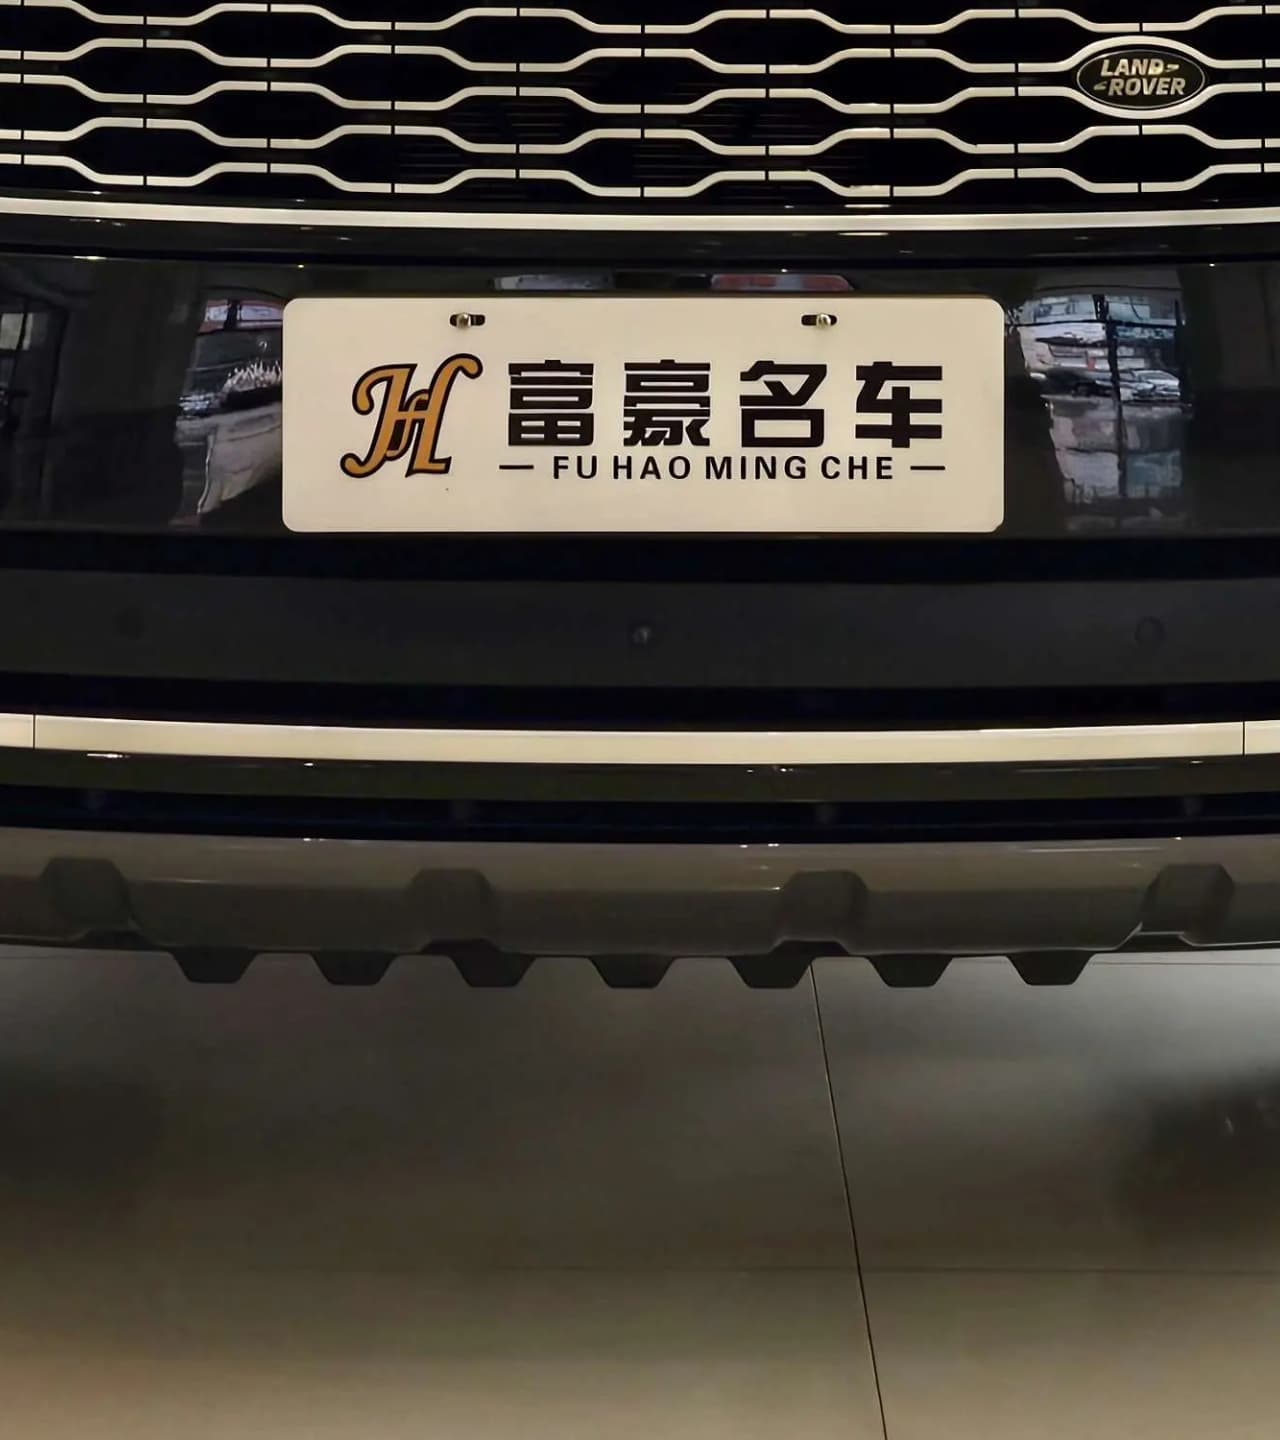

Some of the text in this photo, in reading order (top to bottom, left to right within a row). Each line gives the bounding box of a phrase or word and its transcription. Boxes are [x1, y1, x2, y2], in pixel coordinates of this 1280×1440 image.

[1100, 58, 1164, 77] LAND
[1107, 77, 1186, 97] ROVER
[507, 359, 943, 449] 富豪名车
[553, 455, 893, 480] FU HAO MING CHE
